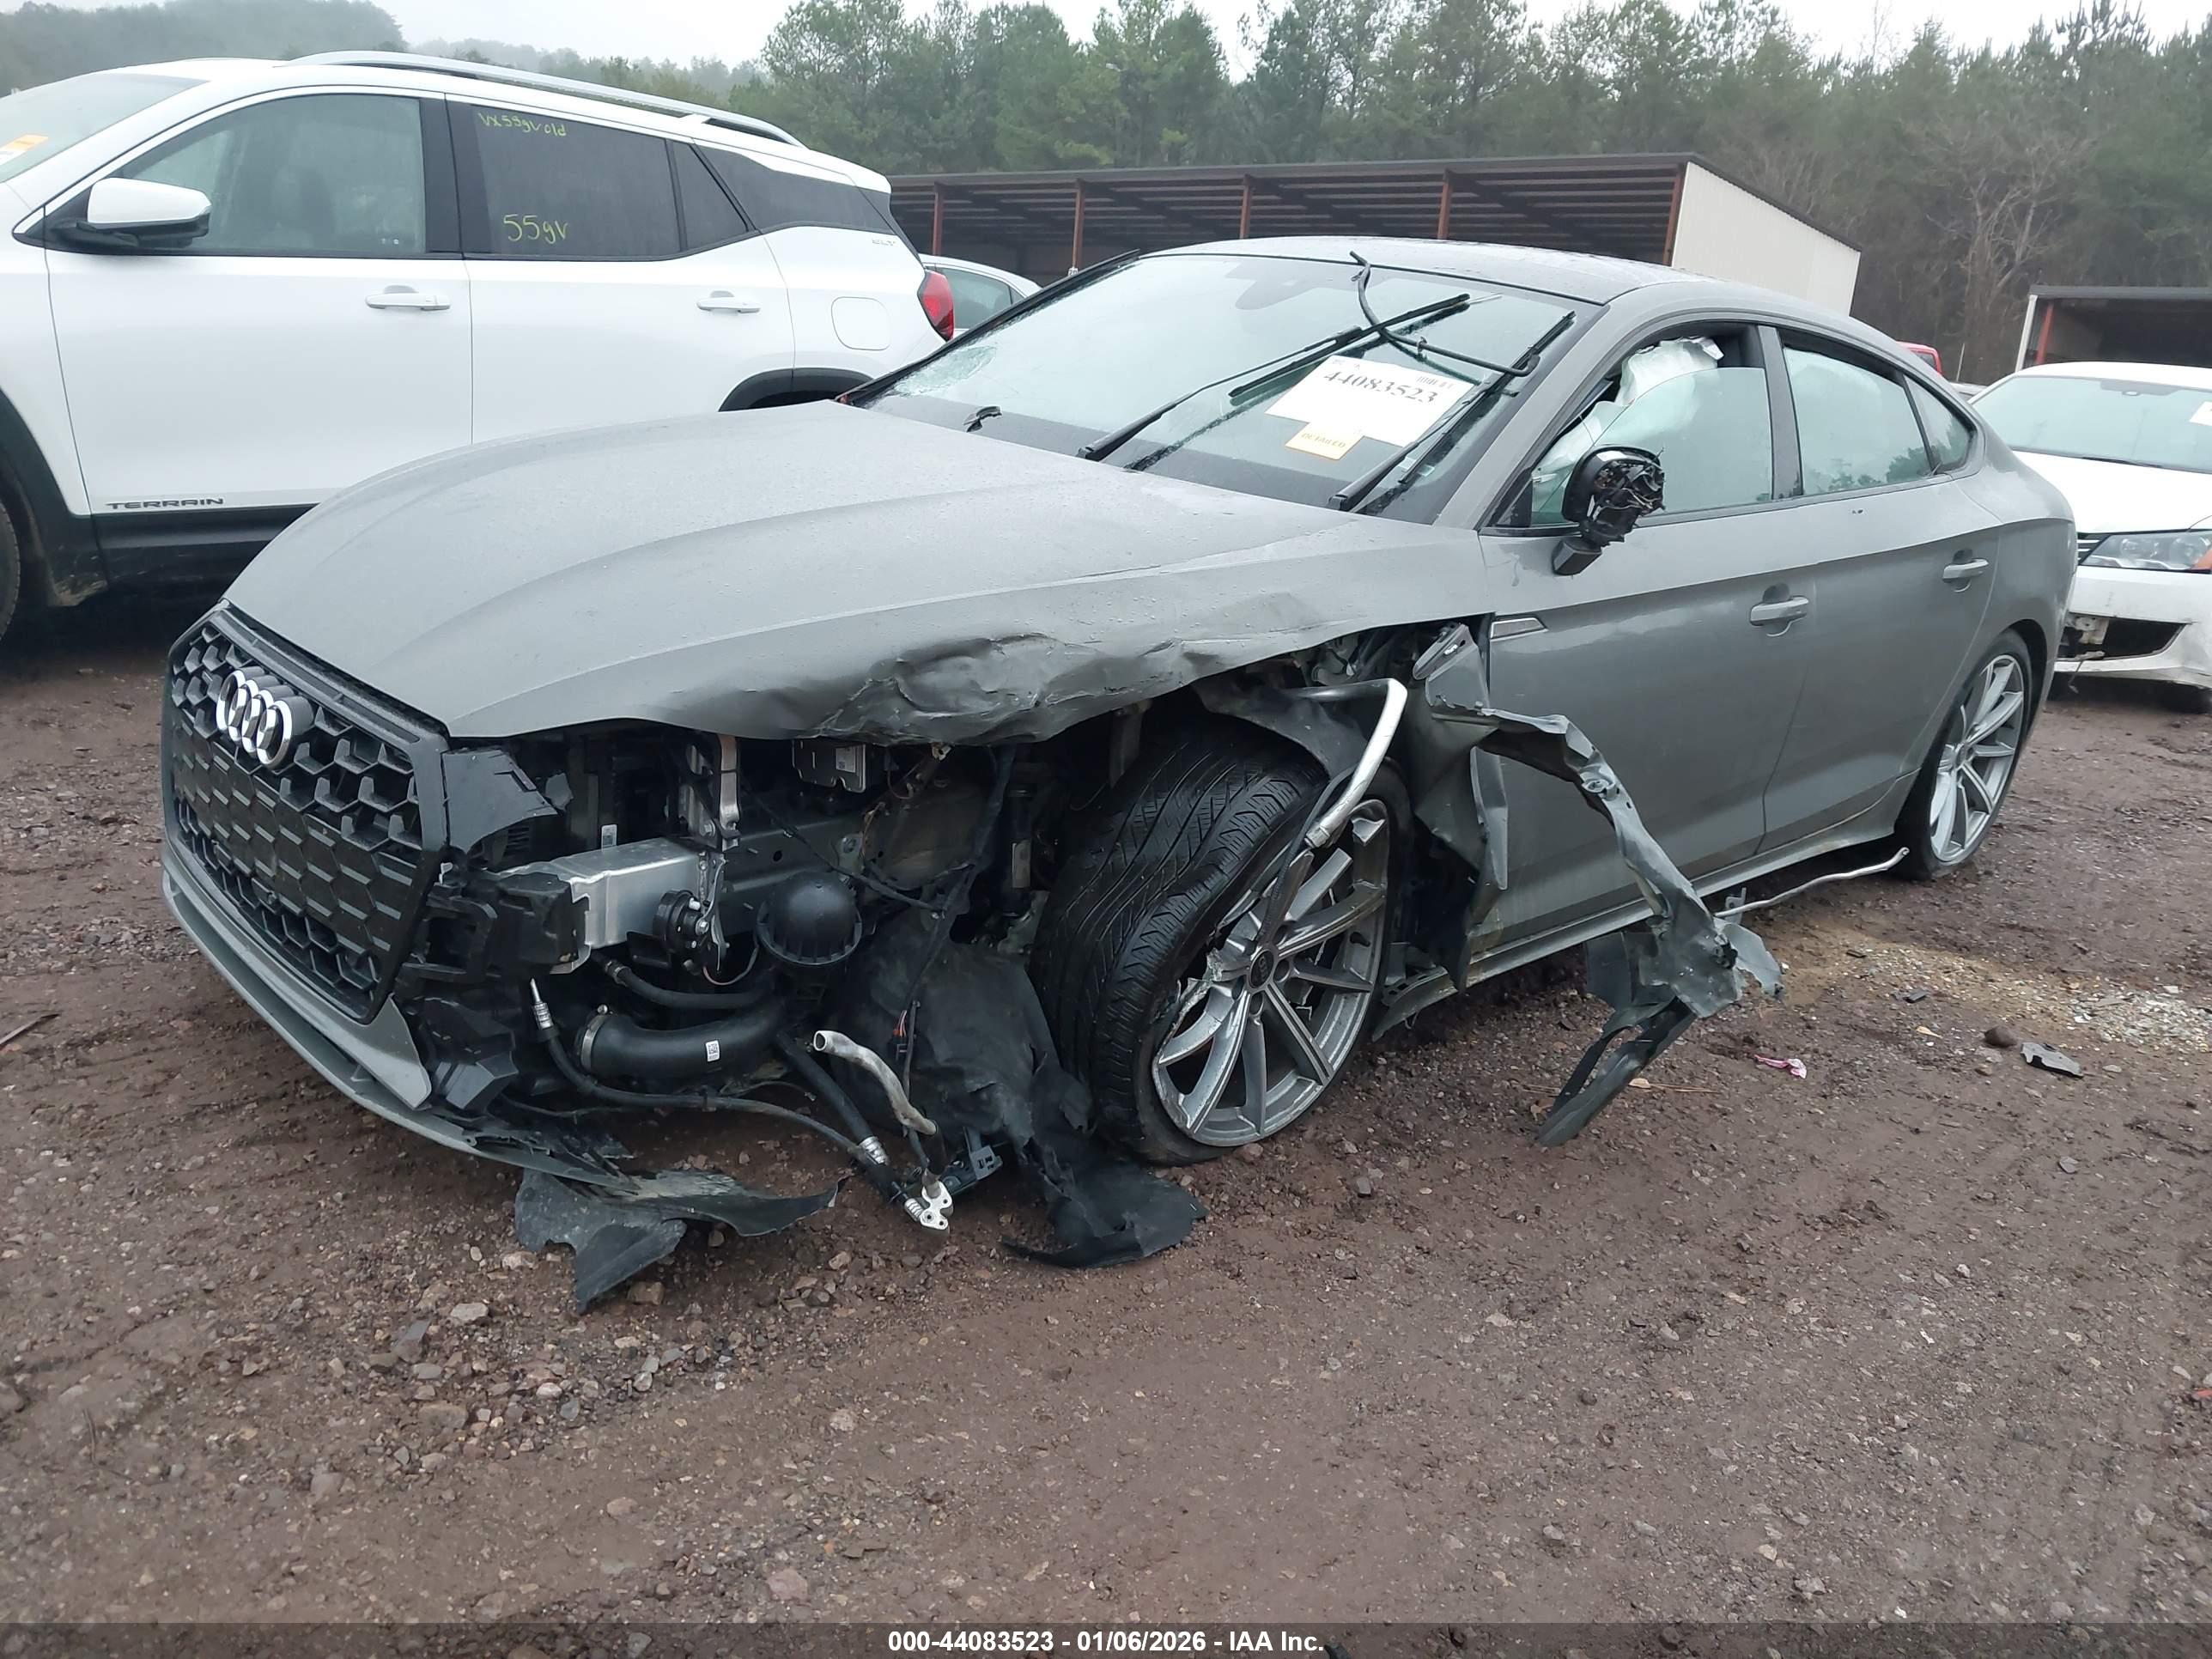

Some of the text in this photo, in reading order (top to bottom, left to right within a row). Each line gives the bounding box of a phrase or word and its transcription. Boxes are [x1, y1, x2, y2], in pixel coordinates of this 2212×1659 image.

[544, 123, 567, 137] old
[1323, 371, 1438, 402] 44083523
[106, 498, 224, 509] TERRAIN
